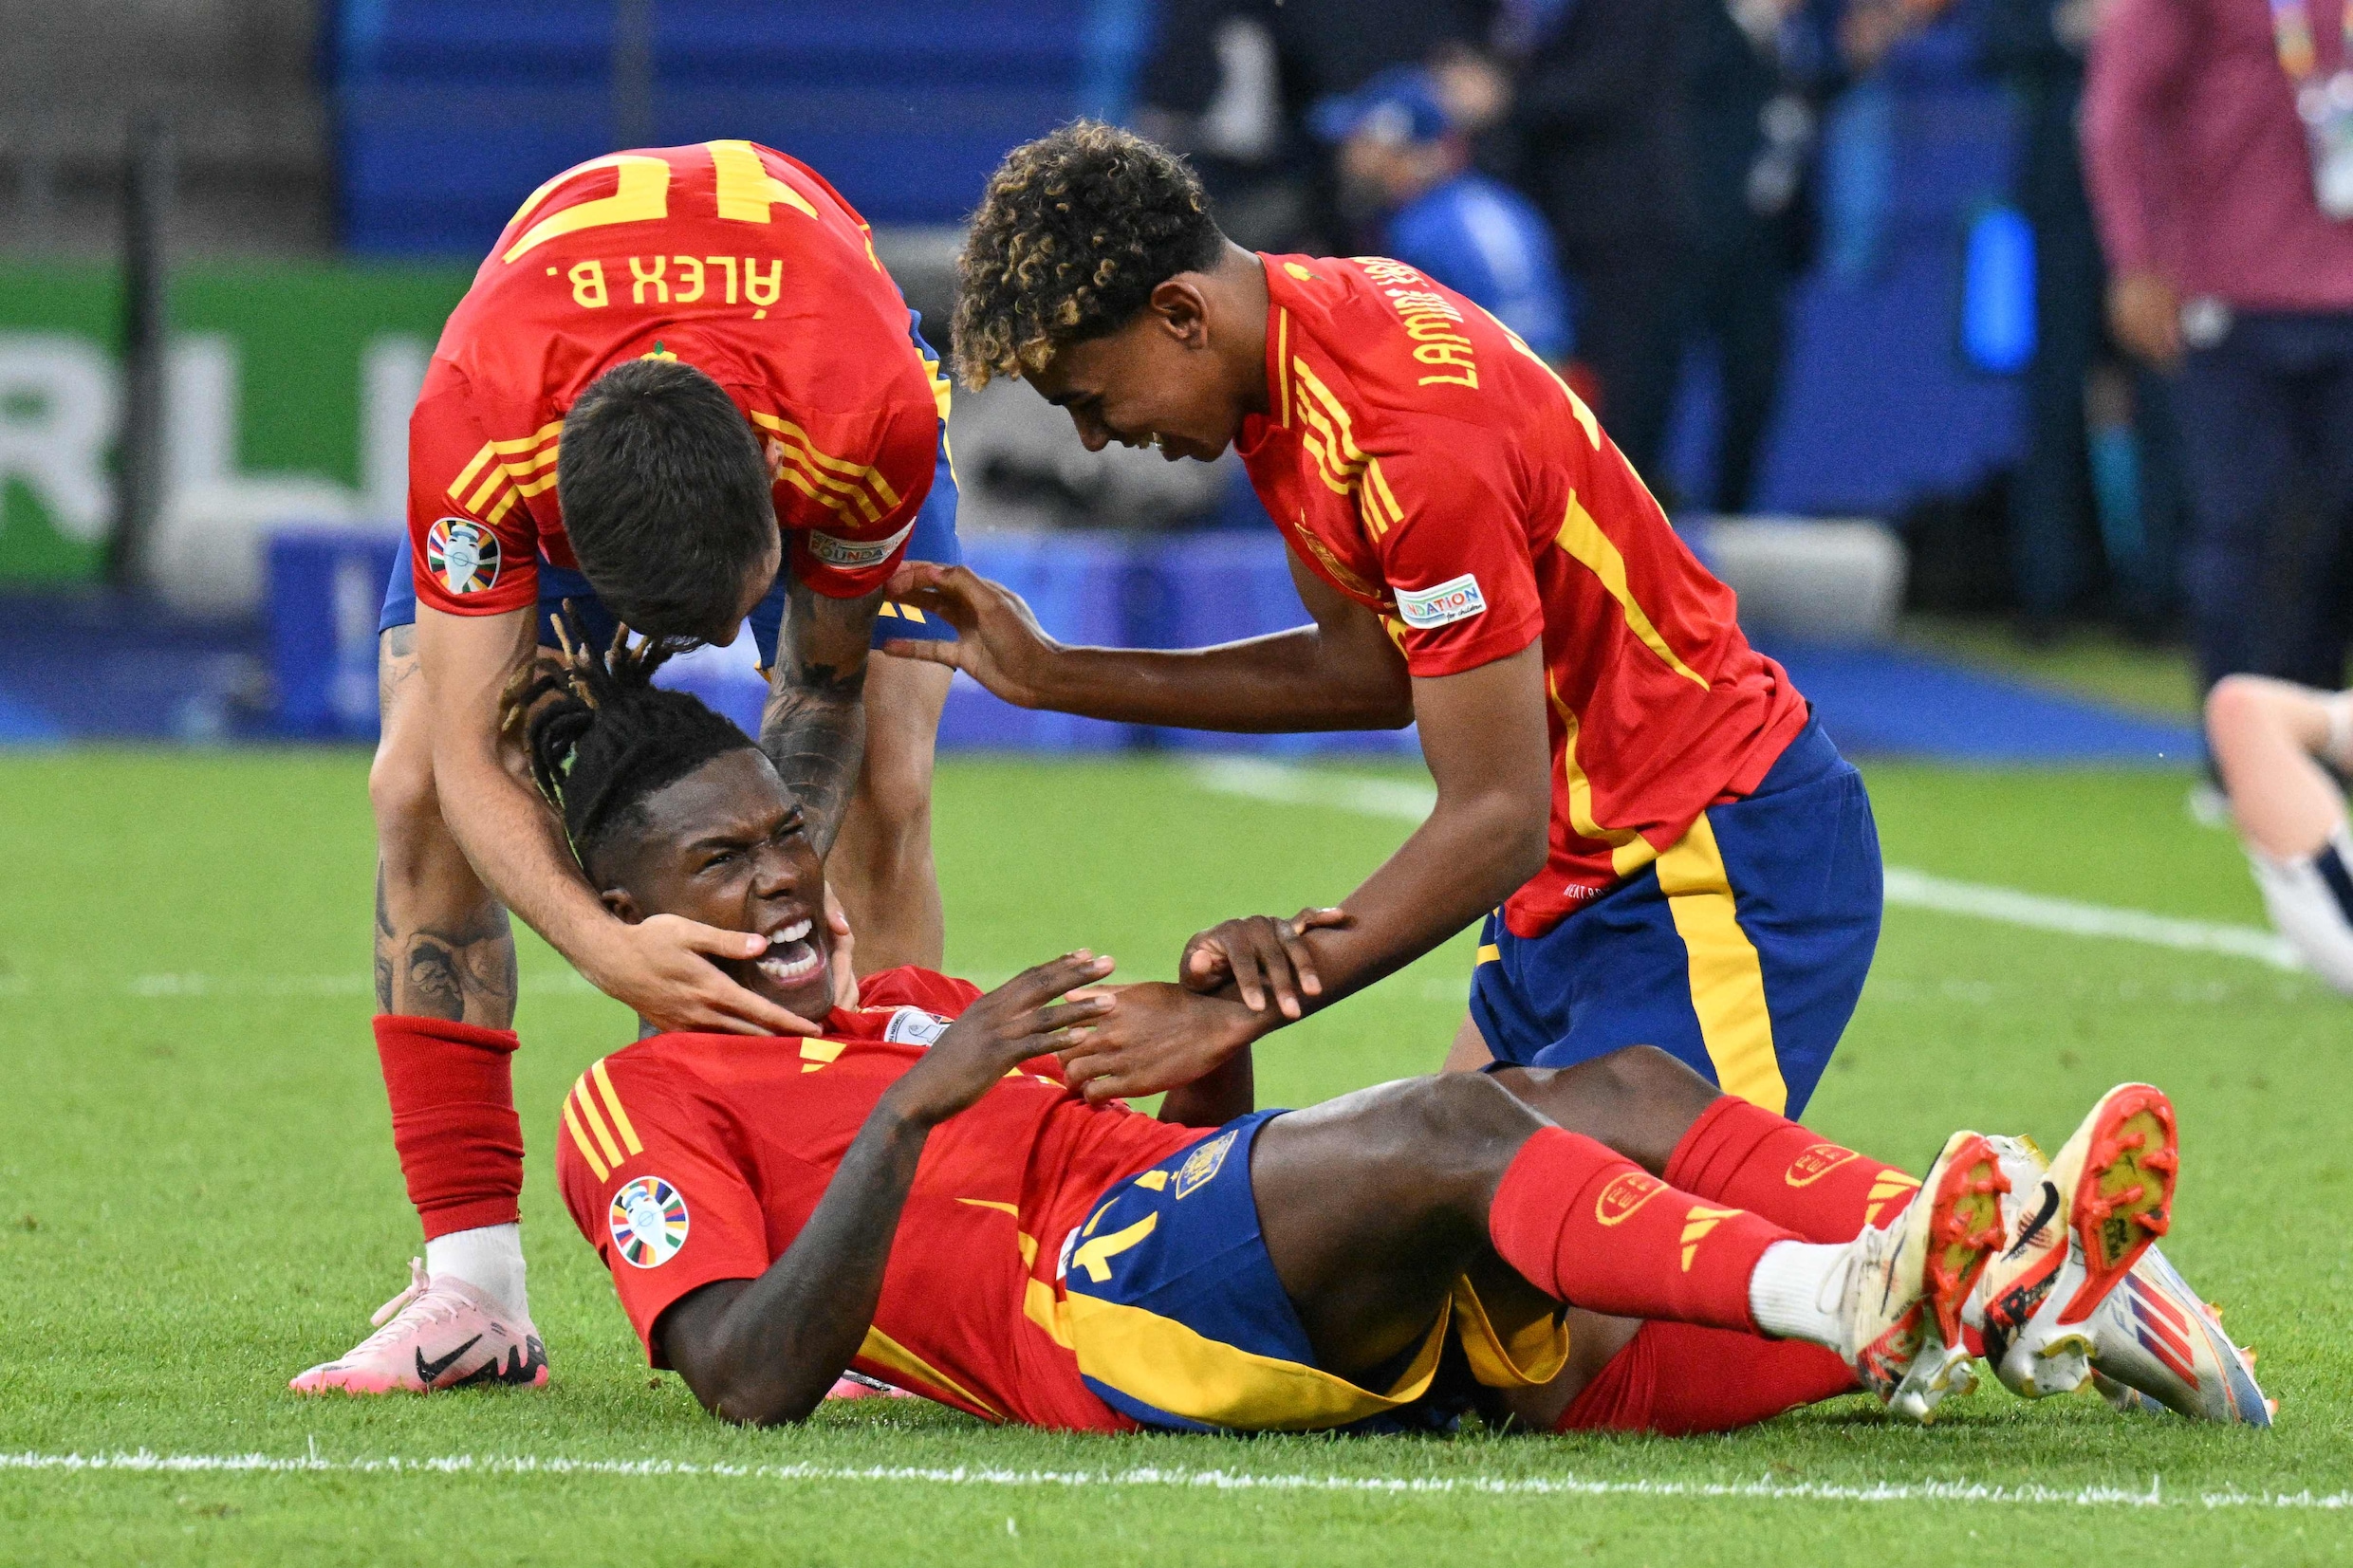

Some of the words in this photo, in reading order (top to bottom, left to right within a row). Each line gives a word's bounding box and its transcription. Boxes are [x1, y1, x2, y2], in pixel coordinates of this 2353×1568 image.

[546, 258, 608, 309] B.
[631, 254, 783, 320] ÁLEX
[1384, 287, 1479, 390] LAMINE
